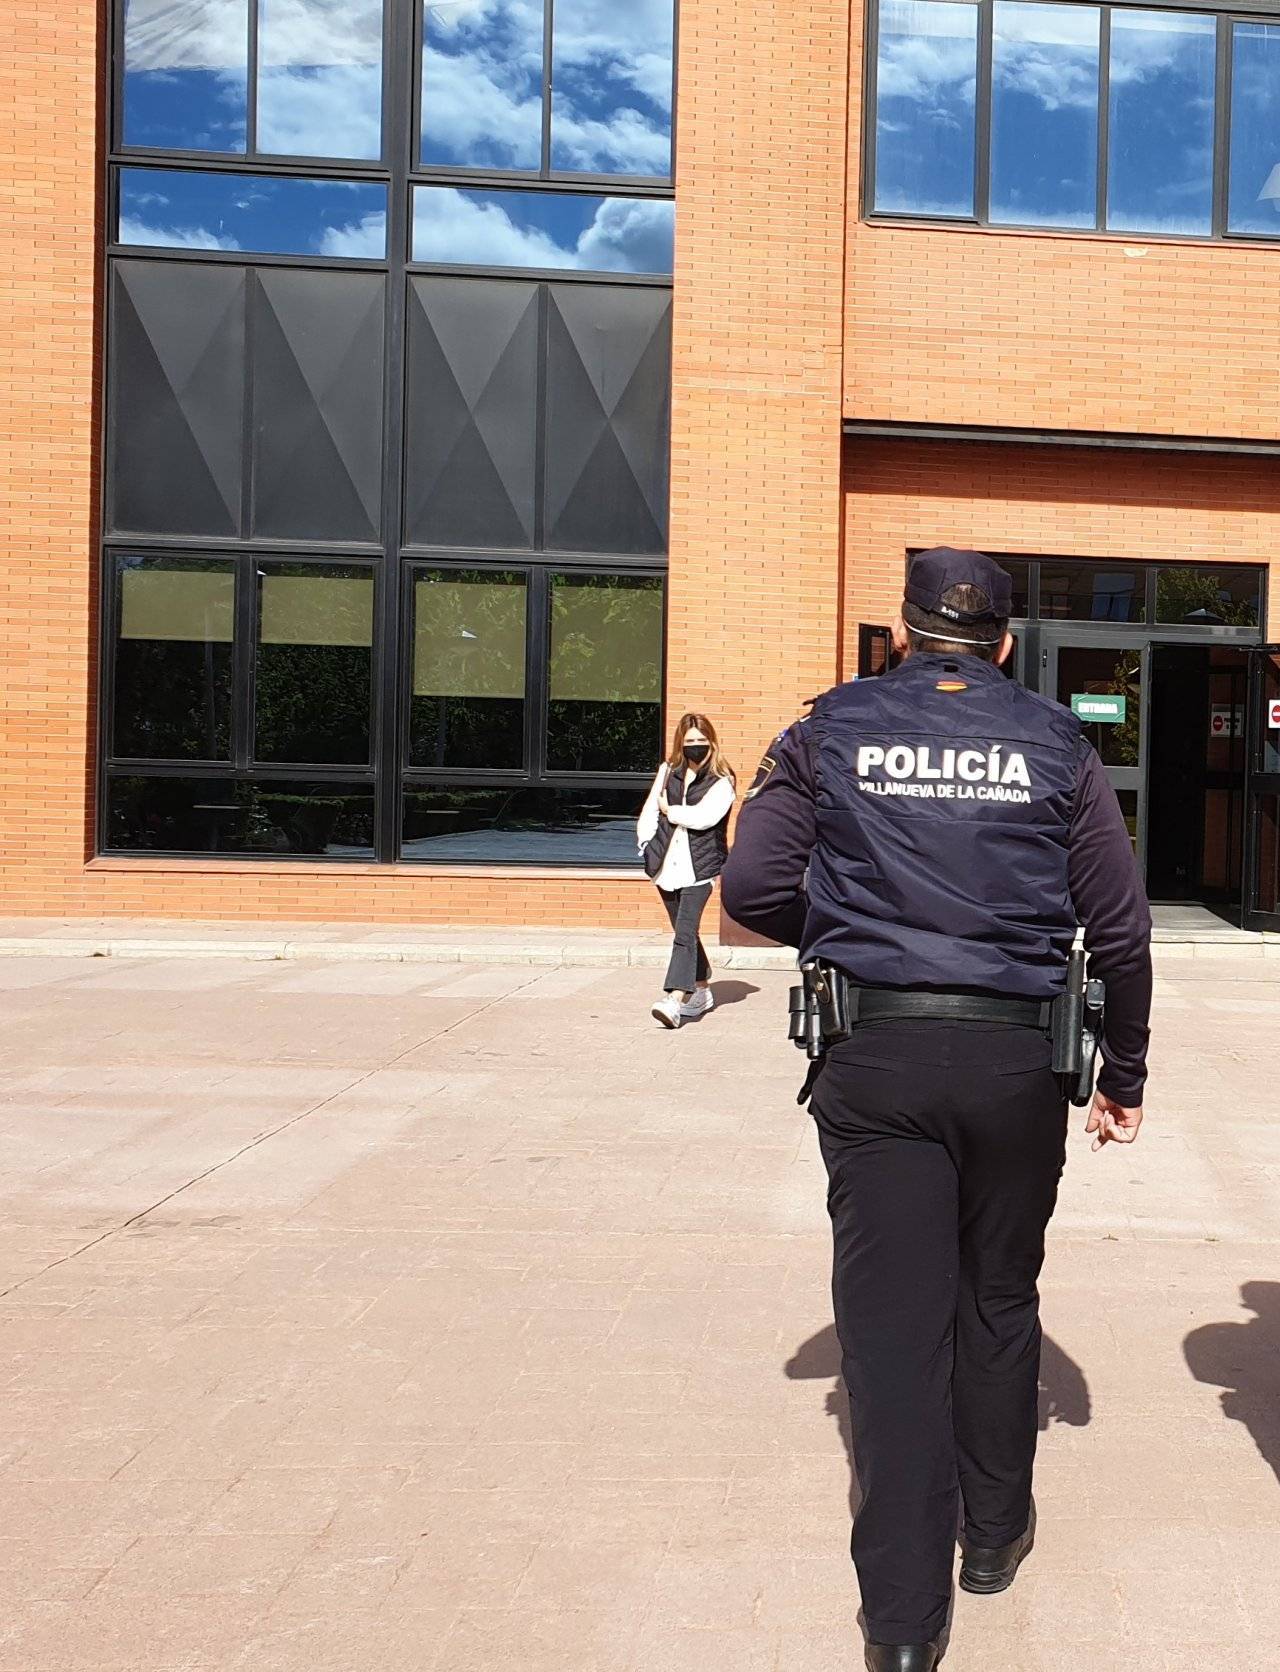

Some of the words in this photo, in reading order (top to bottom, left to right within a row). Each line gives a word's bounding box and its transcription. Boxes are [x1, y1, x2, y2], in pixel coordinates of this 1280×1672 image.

[857, 744, 1032, 787] POLICÍA
[858, 781, 936, 798] VILLANUEVA
[937, 784, 956, 798] DE
[957, 785, 976, 799] LA
[976, 785, 1032, 804] CAÑADA
